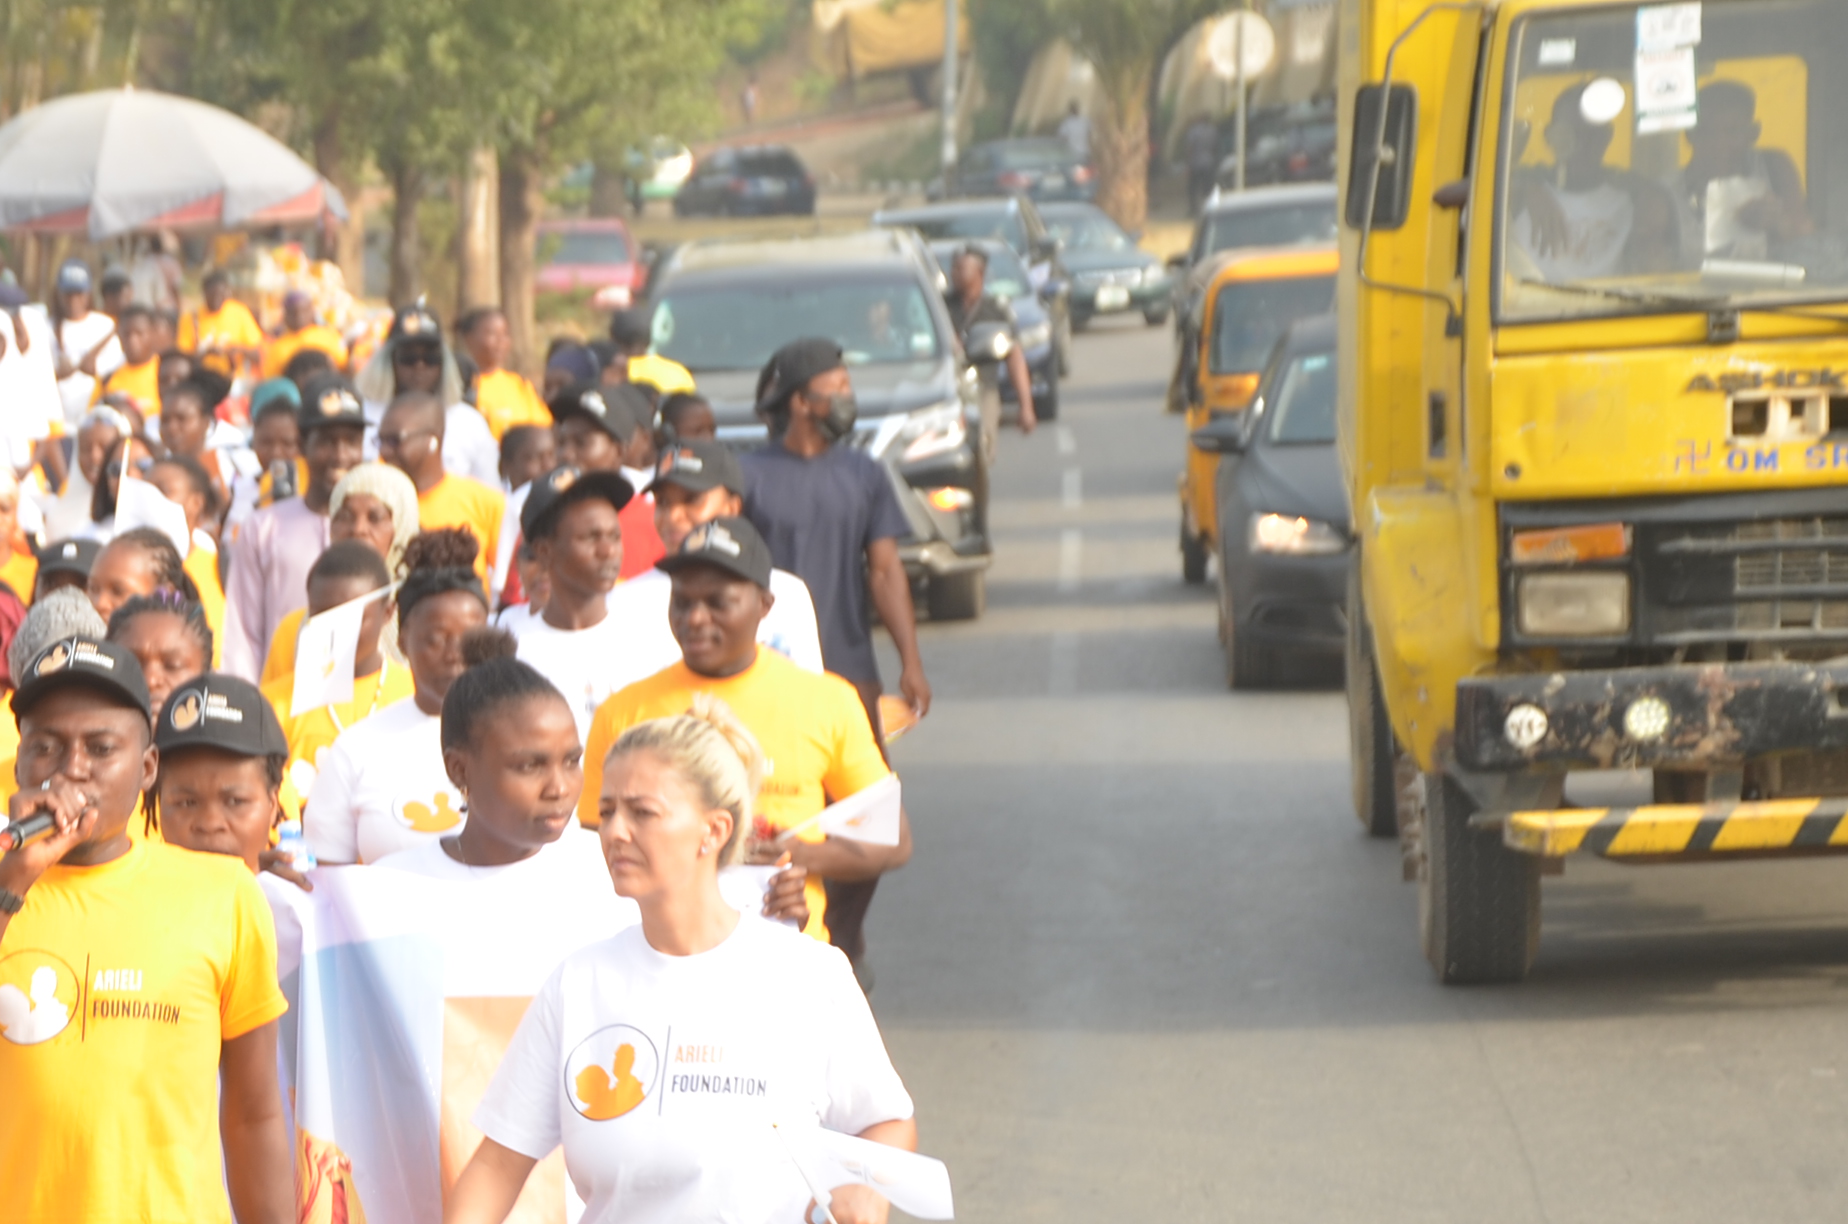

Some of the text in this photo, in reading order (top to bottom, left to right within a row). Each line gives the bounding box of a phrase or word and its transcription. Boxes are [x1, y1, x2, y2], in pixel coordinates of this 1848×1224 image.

[1727, 443, 1848, 471] OM SR
[93, 969, 143, 991] ARIELI
[93, 999, 180, 1025] FOUNDATION
[674, 1045, 723, 1063] ARIELI
[671, 1074, 767, 1097] FOUNDATION
